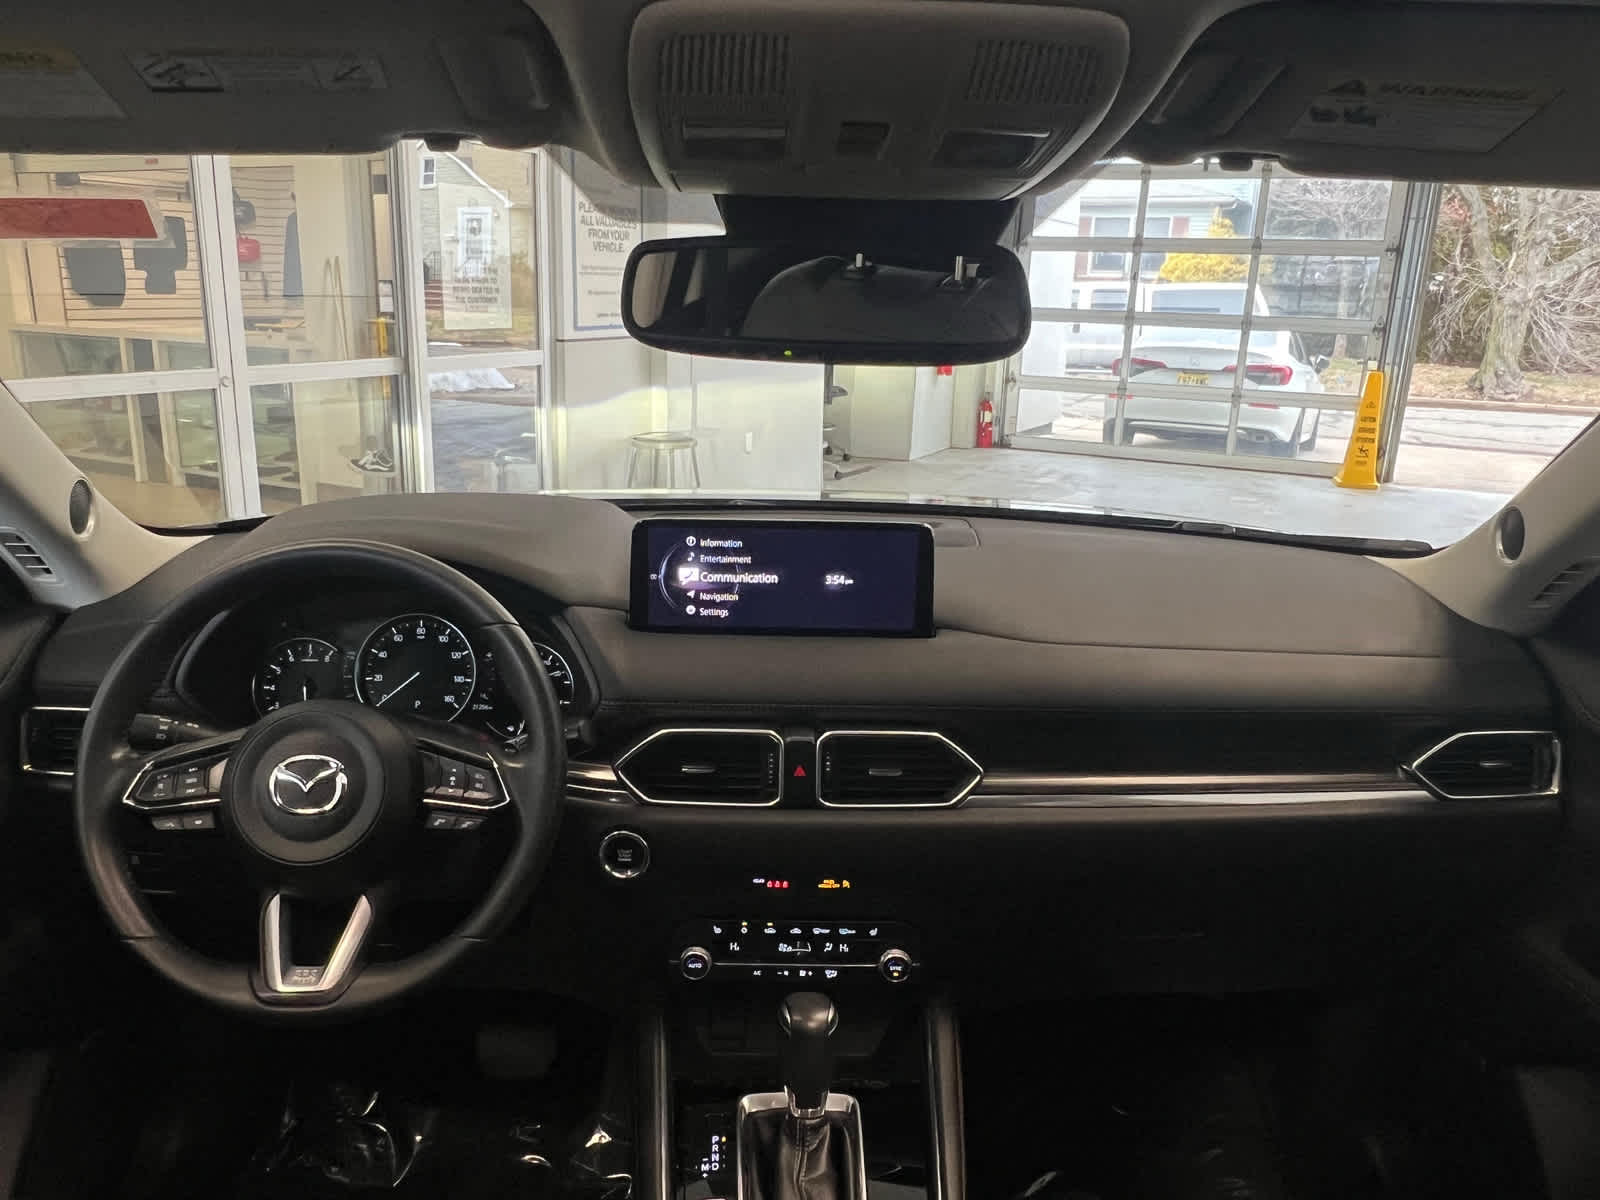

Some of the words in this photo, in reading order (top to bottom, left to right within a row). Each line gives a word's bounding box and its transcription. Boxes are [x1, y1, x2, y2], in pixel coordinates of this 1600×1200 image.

[610, 230, 630, 241] YOUR
[700, 539, 743, 548] Information
[700, 555, 752, 564] Entertainment
[700, 572, 779, 584] Communication
[700, 593, 739, 603] Navigation
[700, 608, 729, 618] Settings
[712, 1136, 719, 1144] P
[712, 1144, 719, 1152] R
[711, 1153, 720, 1162] N
[701, 1163, 710, 1172] M
[711, 1162, 719, 1171] D
